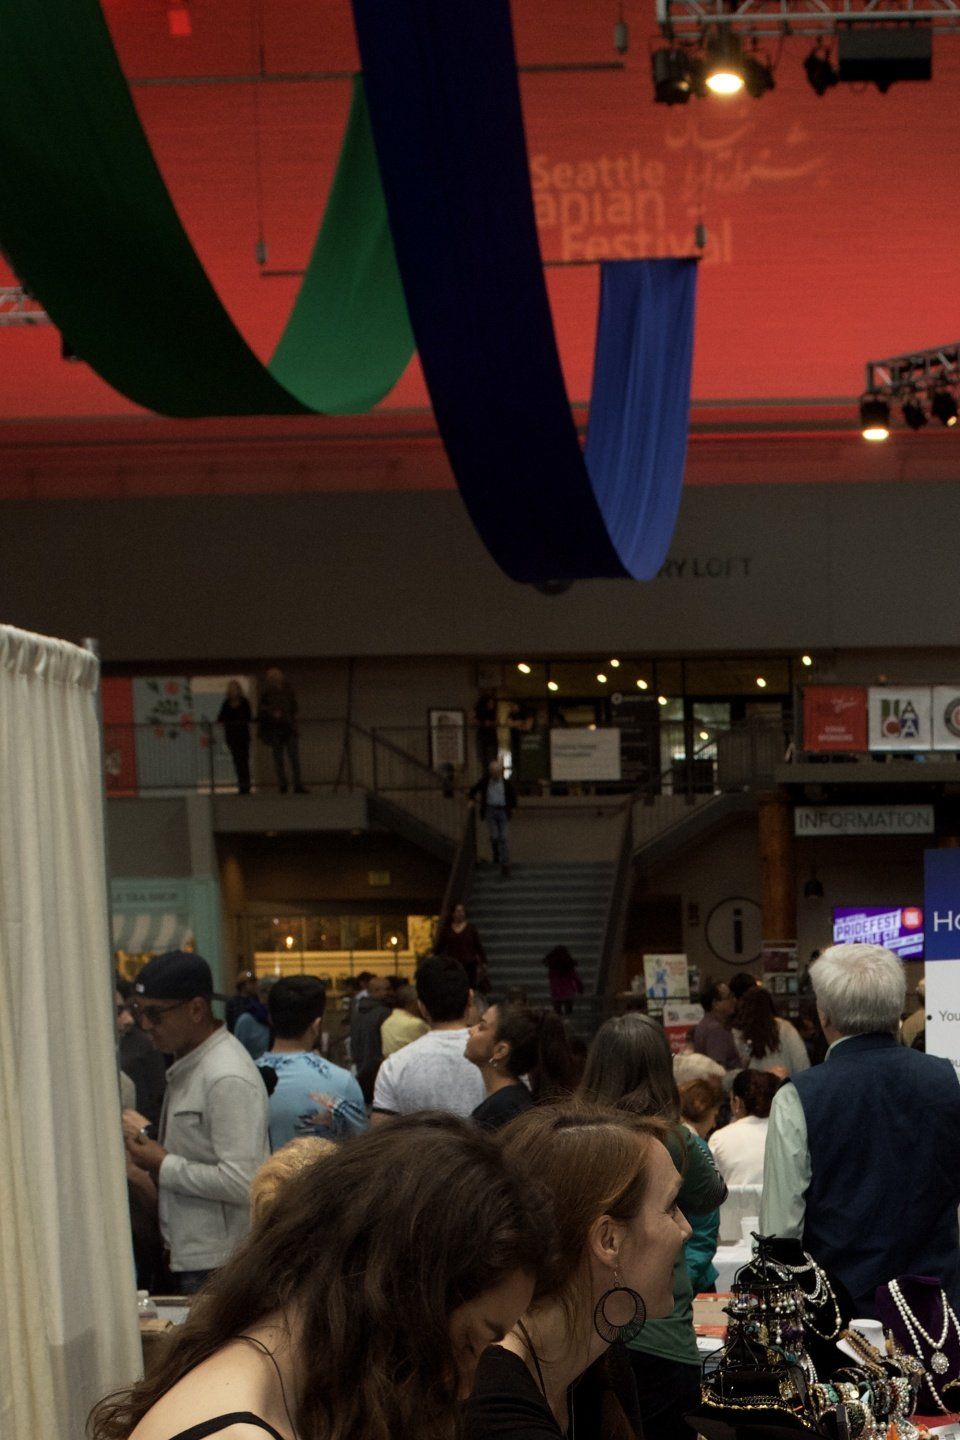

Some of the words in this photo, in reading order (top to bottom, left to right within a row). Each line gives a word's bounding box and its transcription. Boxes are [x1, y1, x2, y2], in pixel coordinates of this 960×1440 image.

[531, 150, 666, 190] Seattle
[798, 806, 933, 829] INFORMATION
[836, 914, 898, 938] PRIDEFEST
